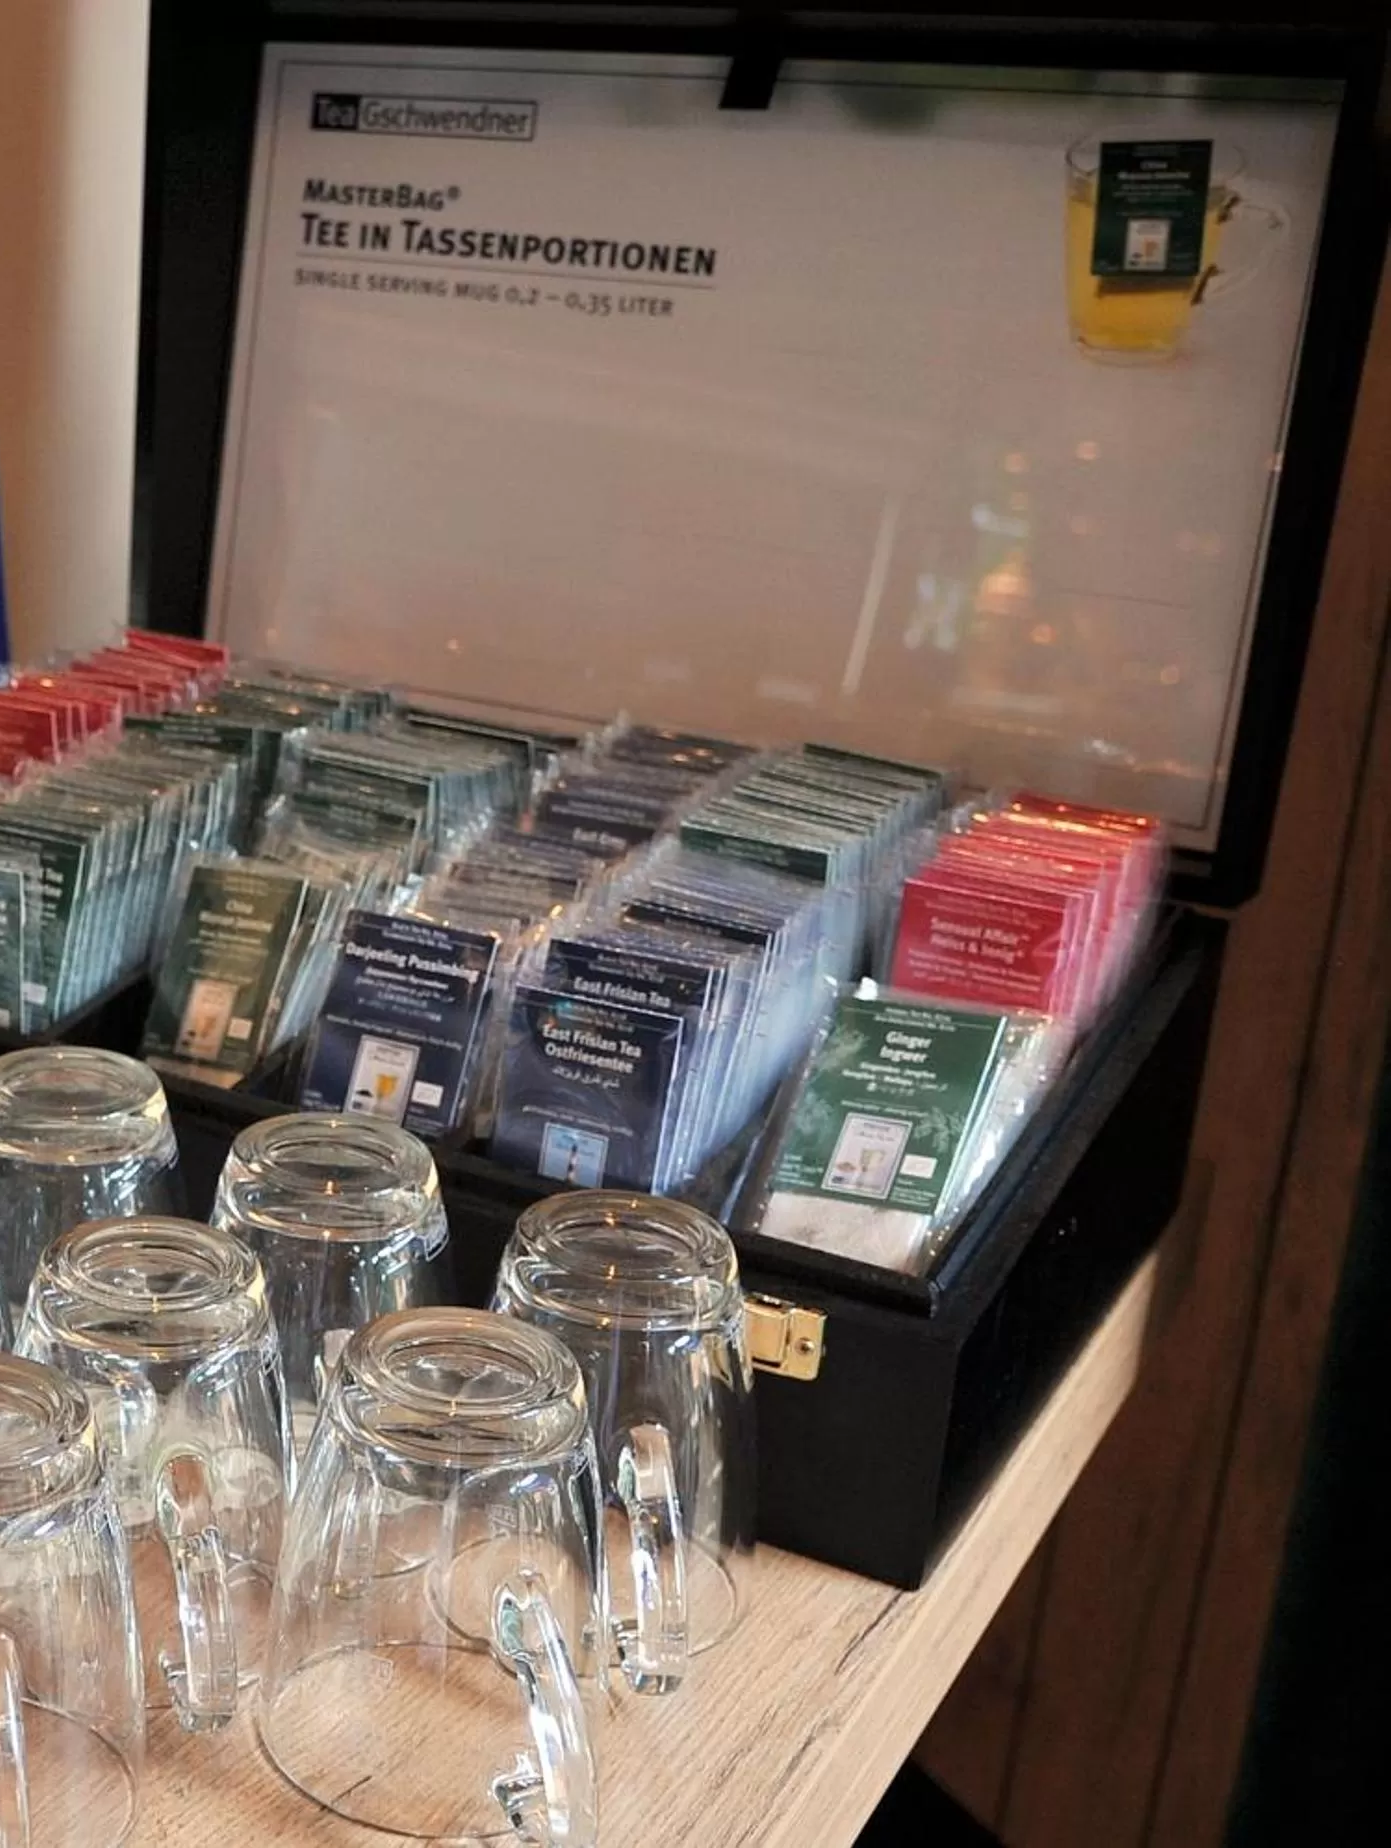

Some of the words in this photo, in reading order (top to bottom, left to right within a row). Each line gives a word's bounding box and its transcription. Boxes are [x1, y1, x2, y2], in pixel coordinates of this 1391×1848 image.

[401, 217, 717, 276] TASSENPORTIONEN
[294, 267, 360, 290] SINGLE
[367, 273, 448, 298] SERVING
[455, 280, 500, 302] MUG
[616, 296, 675, 317] LITER
[346, 941, 407, 968] Darjeeling
[573, 975, 602, 995] East
[603, 981, 647, 1004] Frisian
[648, 990, 672, 1009] Tea
[541, 1022, 571, 1042] East
[572, 1029, 618, 1052] Frisian
[619, 1039, 643, 1058] Tea
[879, 1044, 929, 1064] Ingwer
[885, 1029, 933, 1050] Ginger
